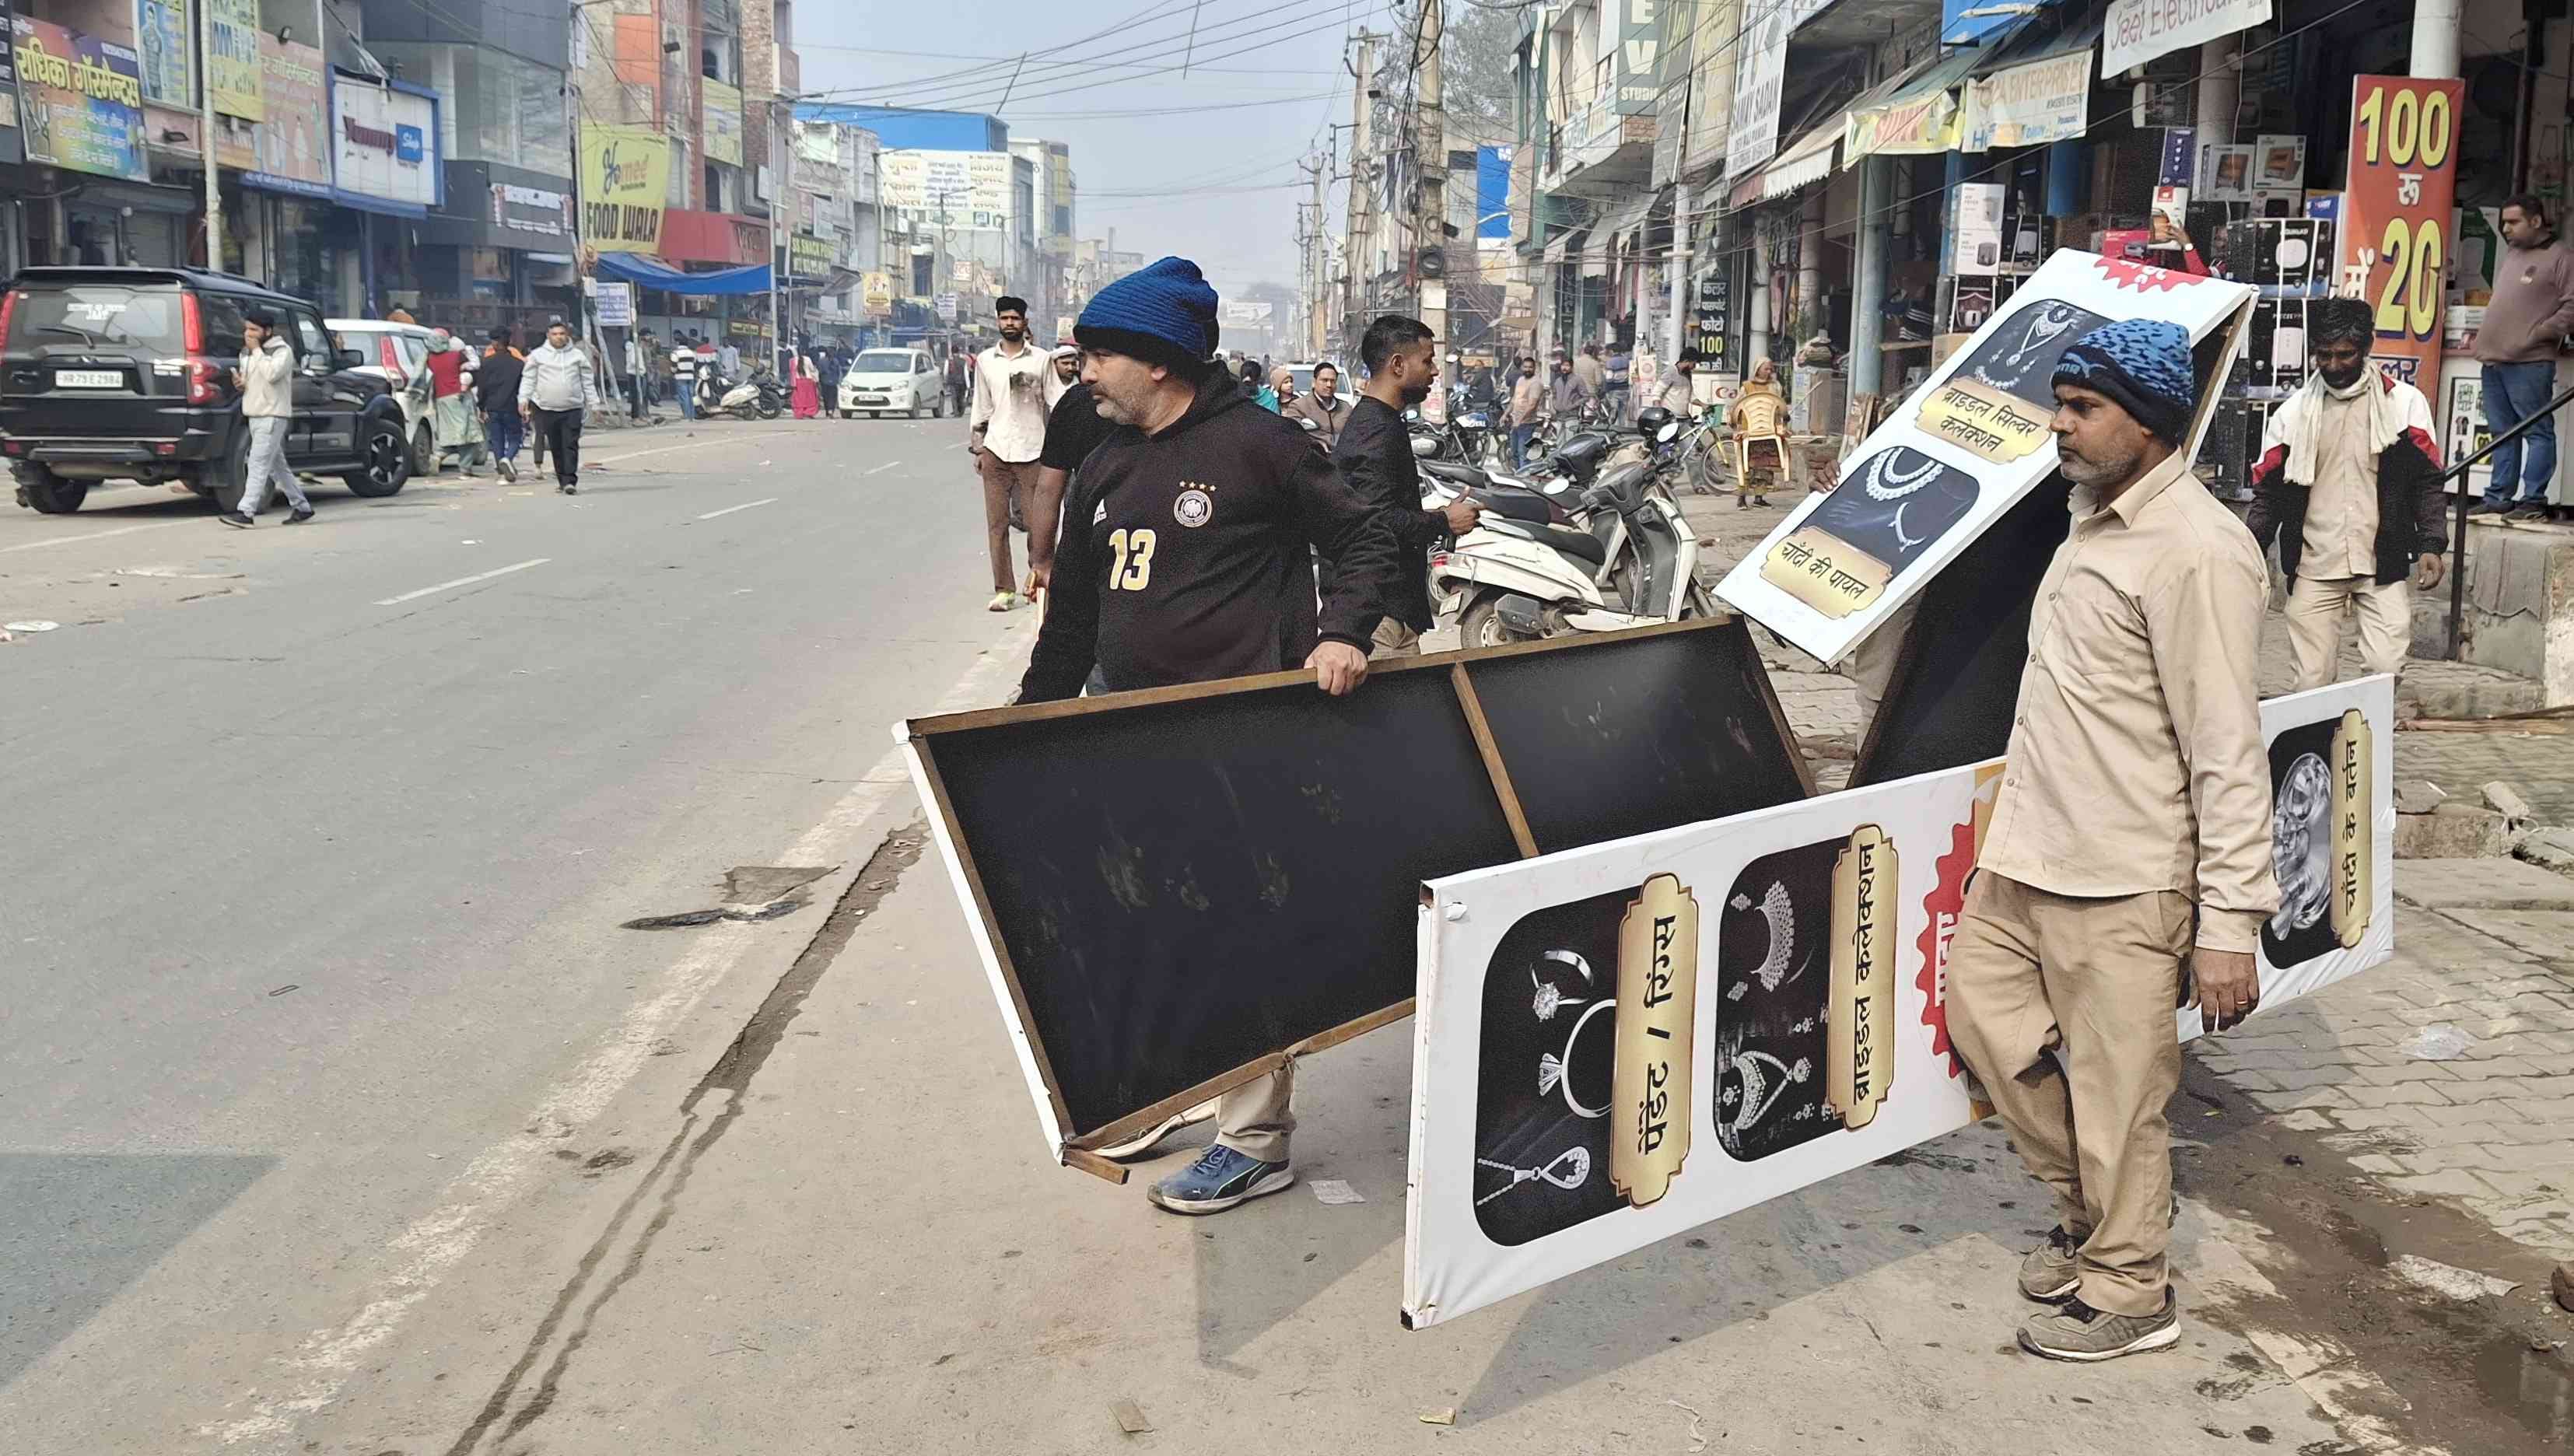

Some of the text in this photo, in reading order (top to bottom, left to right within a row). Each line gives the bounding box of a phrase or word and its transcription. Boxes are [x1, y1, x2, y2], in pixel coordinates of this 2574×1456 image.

[2359, 86, 2451, 168] 100
[587, 201, 619, 240] FOOD
[622, 204, 659, 243] WALA
[1703, 282, 1726, 296] कलर
[2375, 217, 2442, 334] 20
[1700, 336, 1724, 353] 100
[1701, 315, 1725, 331] फोटो
[1940, 415, 2005, 453] कलेक्शन
[1990, 404, 2040, 437] सिल्वर
[1108, 528, 1157, 591] 13
[1781, 541, 1869, 600] चाँदी की पायल
[2342, 812, 2357, 843] के
[2341, 852, 2357, 916] चाँदी
[1643, 915, 1676, 1009] रिंग्स
[1851, 842, 1875, 1106] ब्राइडल कलेक्शन
[1637, 1061, 1669, 1155] पेंडेंट
